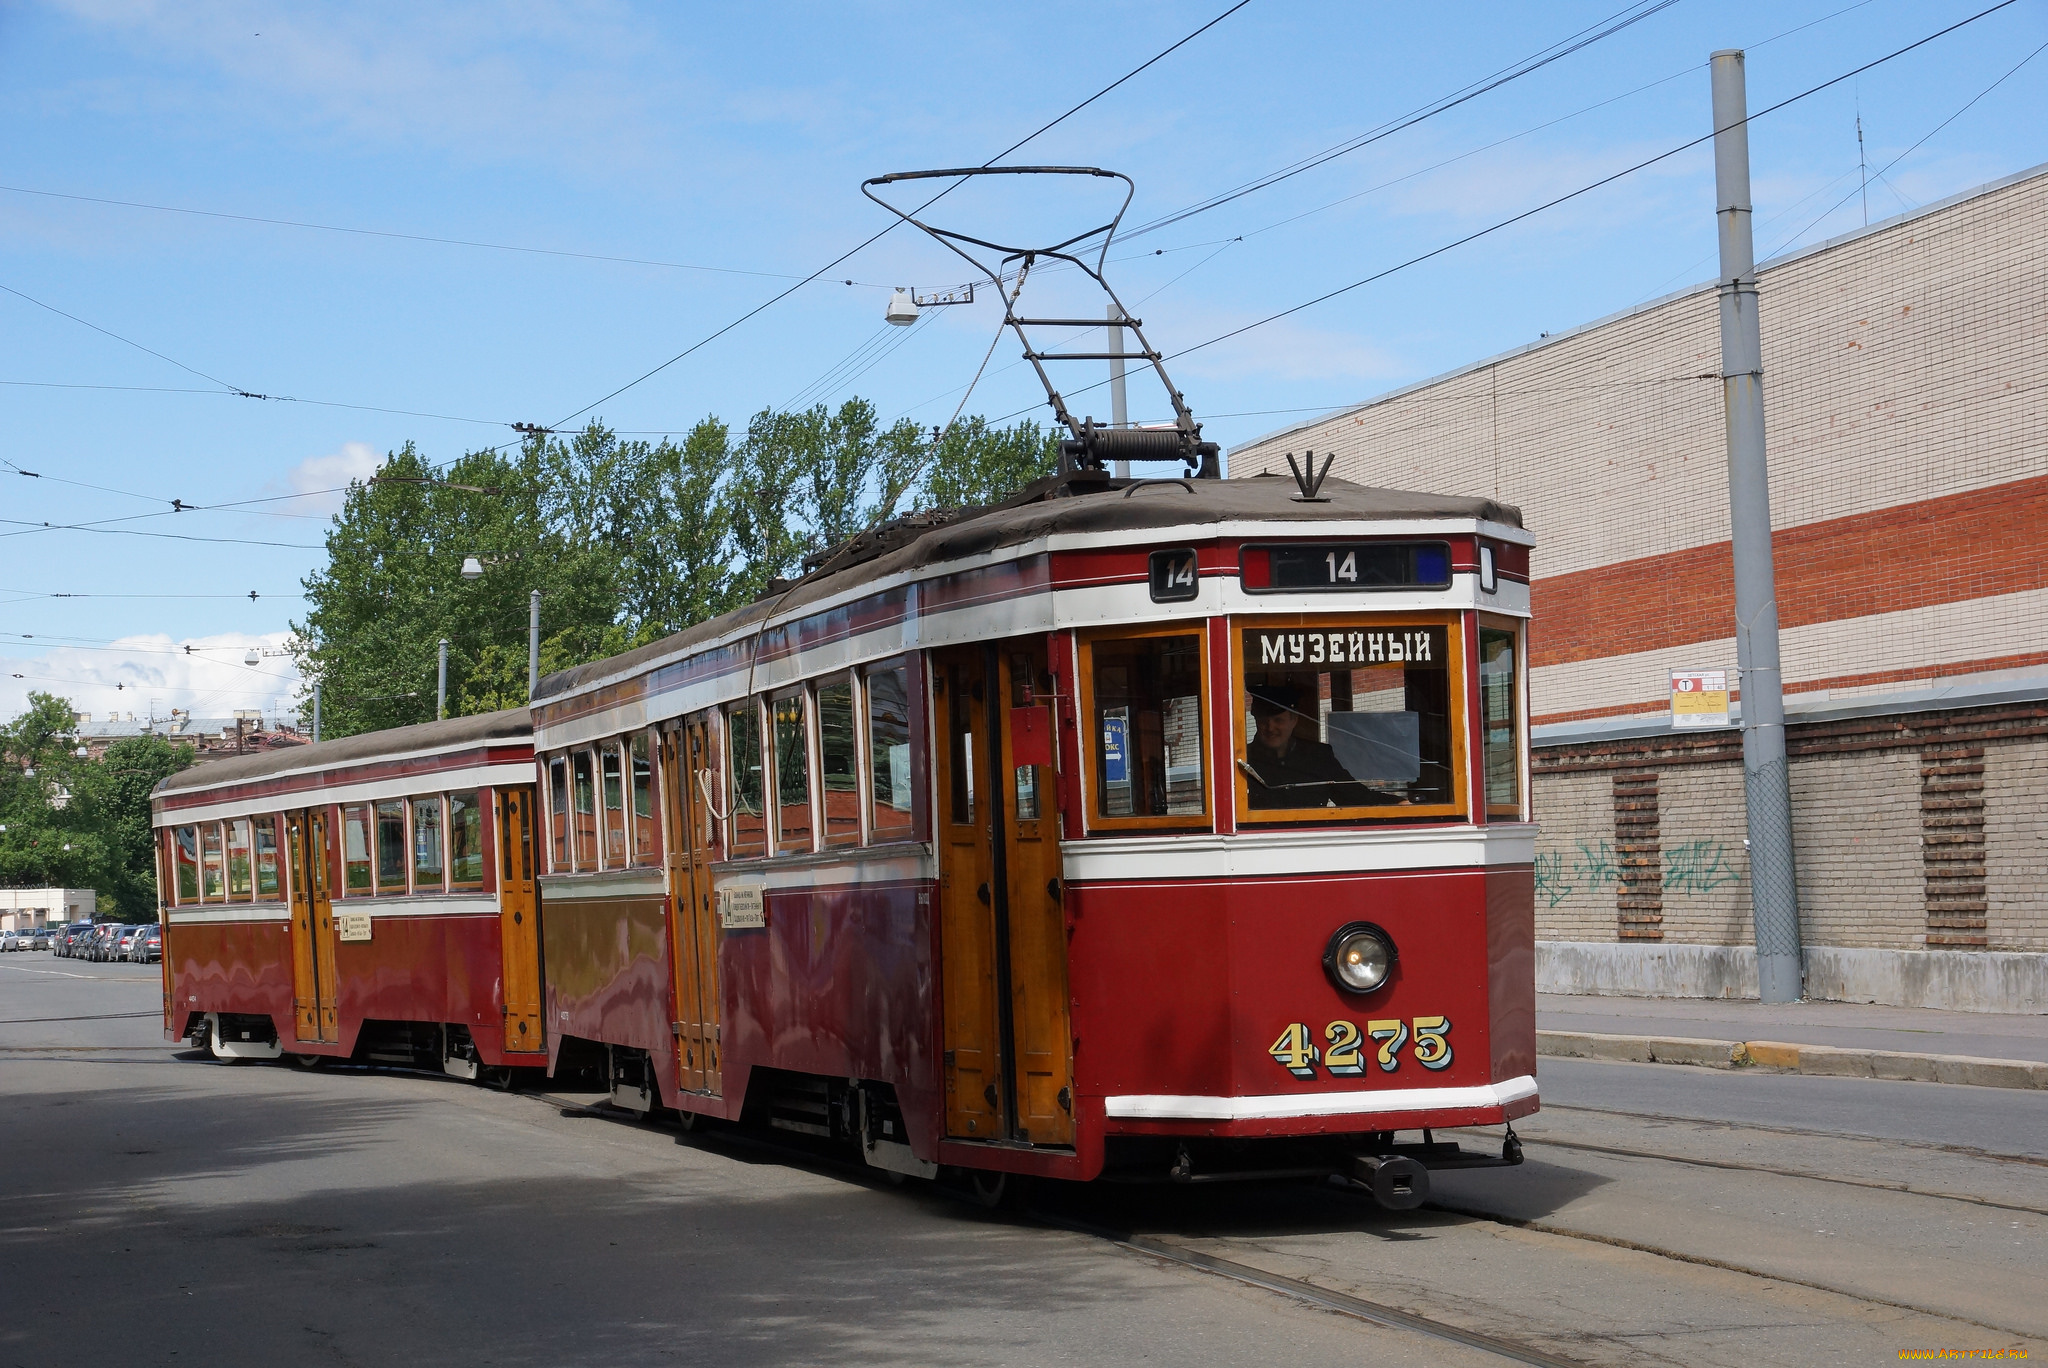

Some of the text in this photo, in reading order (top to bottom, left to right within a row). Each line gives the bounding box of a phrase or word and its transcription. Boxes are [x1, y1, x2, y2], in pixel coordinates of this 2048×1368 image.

[1166, 557, 1194, 589] 14
[1325, 551, 1358, 583] 14
[1260, 630, 1432, 664] МУЗЕЙНЫЙ
[1268, 1015, 1454, 1080] 4275
